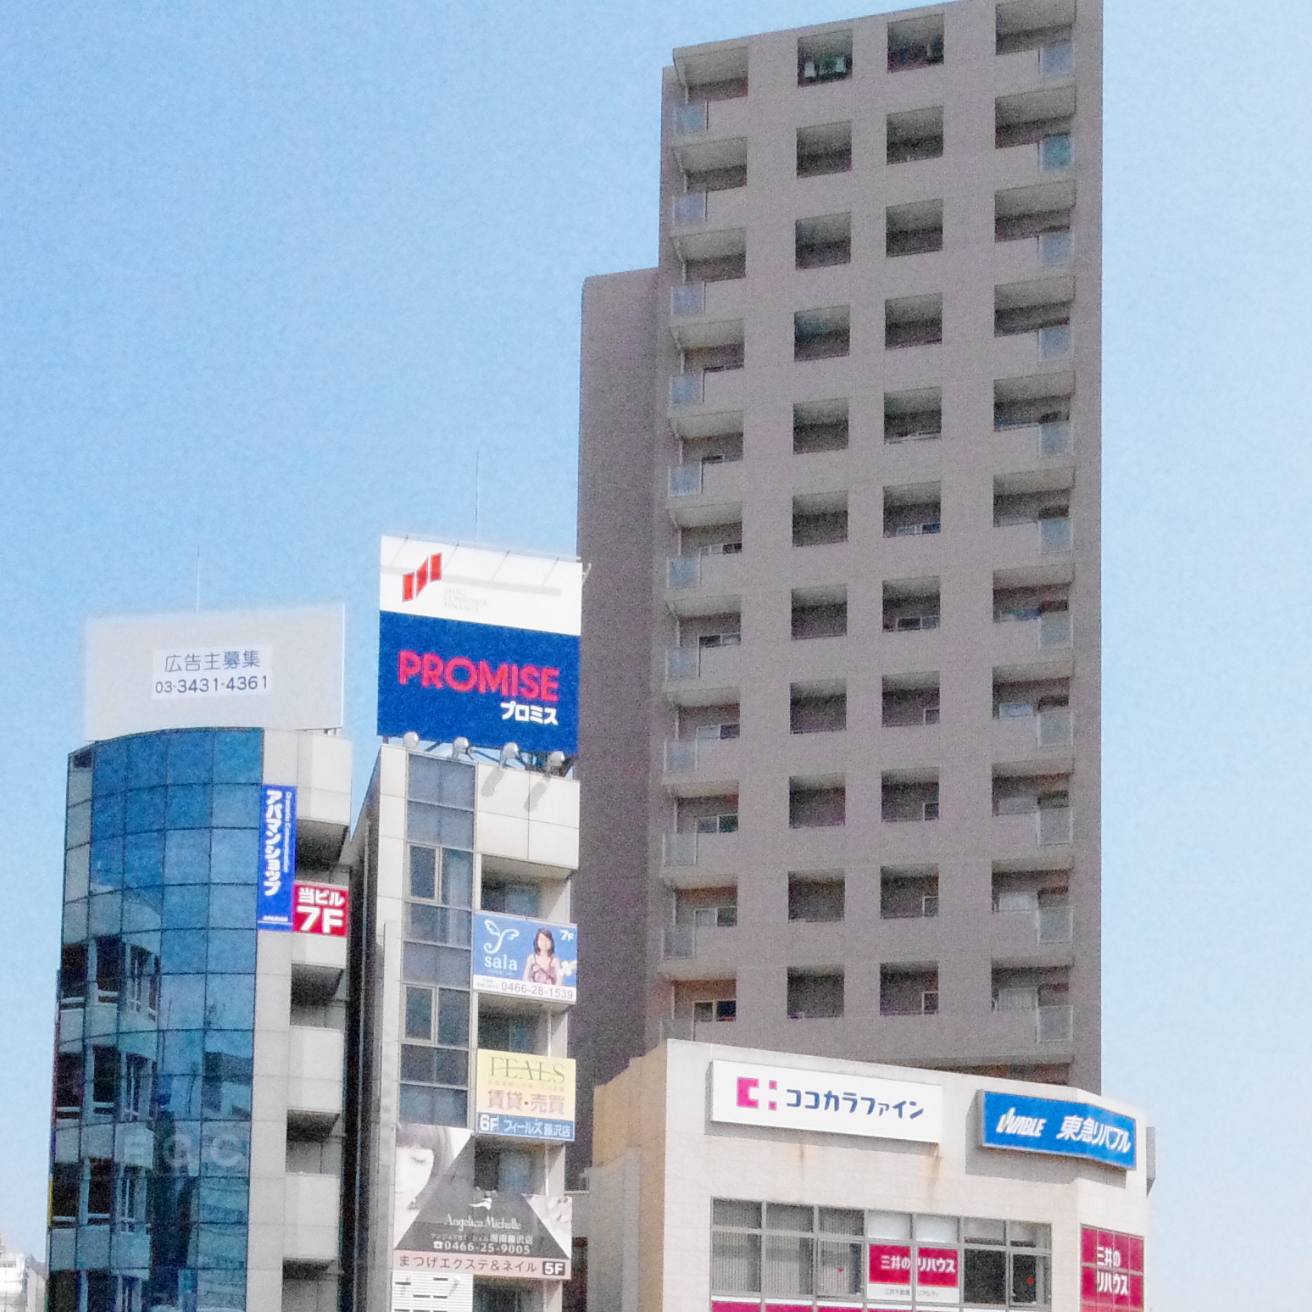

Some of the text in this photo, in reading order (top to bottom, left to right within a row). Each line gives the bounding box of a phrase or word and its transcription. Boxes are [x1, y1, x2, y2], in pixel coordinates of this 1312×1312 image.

[445, 595, 488, 606] CONSUMER
[445, 602, 479, 613] FINANCE
[165, 650, 260, 672] 広告主募集
[155, 675, 267, 693] 03-3431-4361
[398, 650, 560, 702] PROMISE
[500, 701, 559, 725] プロミス
[264, 790, 283, 896] アパマンショップ
[298, 887, 344, 906] 当ビル
[296, 905, 344, 934] 7F
[560, 929, 574, 941] 7F
[484, 955, 517, 971] sala
[501, 981, 573, 1000] 0466-28-1539
[488, 1089, 565, 1115] 賃貸・売買
[786, 1087, 924, 1121] ココカラファイン
[479, 1115, 499, 1132] 6F
[503, 1119, 571, 1138] フィールズ藤沢店
[1056, 1115, 1131, 1154] 東急リバブル
[444, 1213, 522, 1231] Angelica Michelle
[444, 1241, 531, 1255] 0466-25-9005
[1097, 1246, 1121, 1268] 三井の
[399, 1255, 537, 1273] まつげエクステ&ネイル
[545, 1262, 564, 1275] 5F
[881, 1255, 956, 1273] 三井のリハウス
[1097, 1271, 1128, 1295] リハウス
